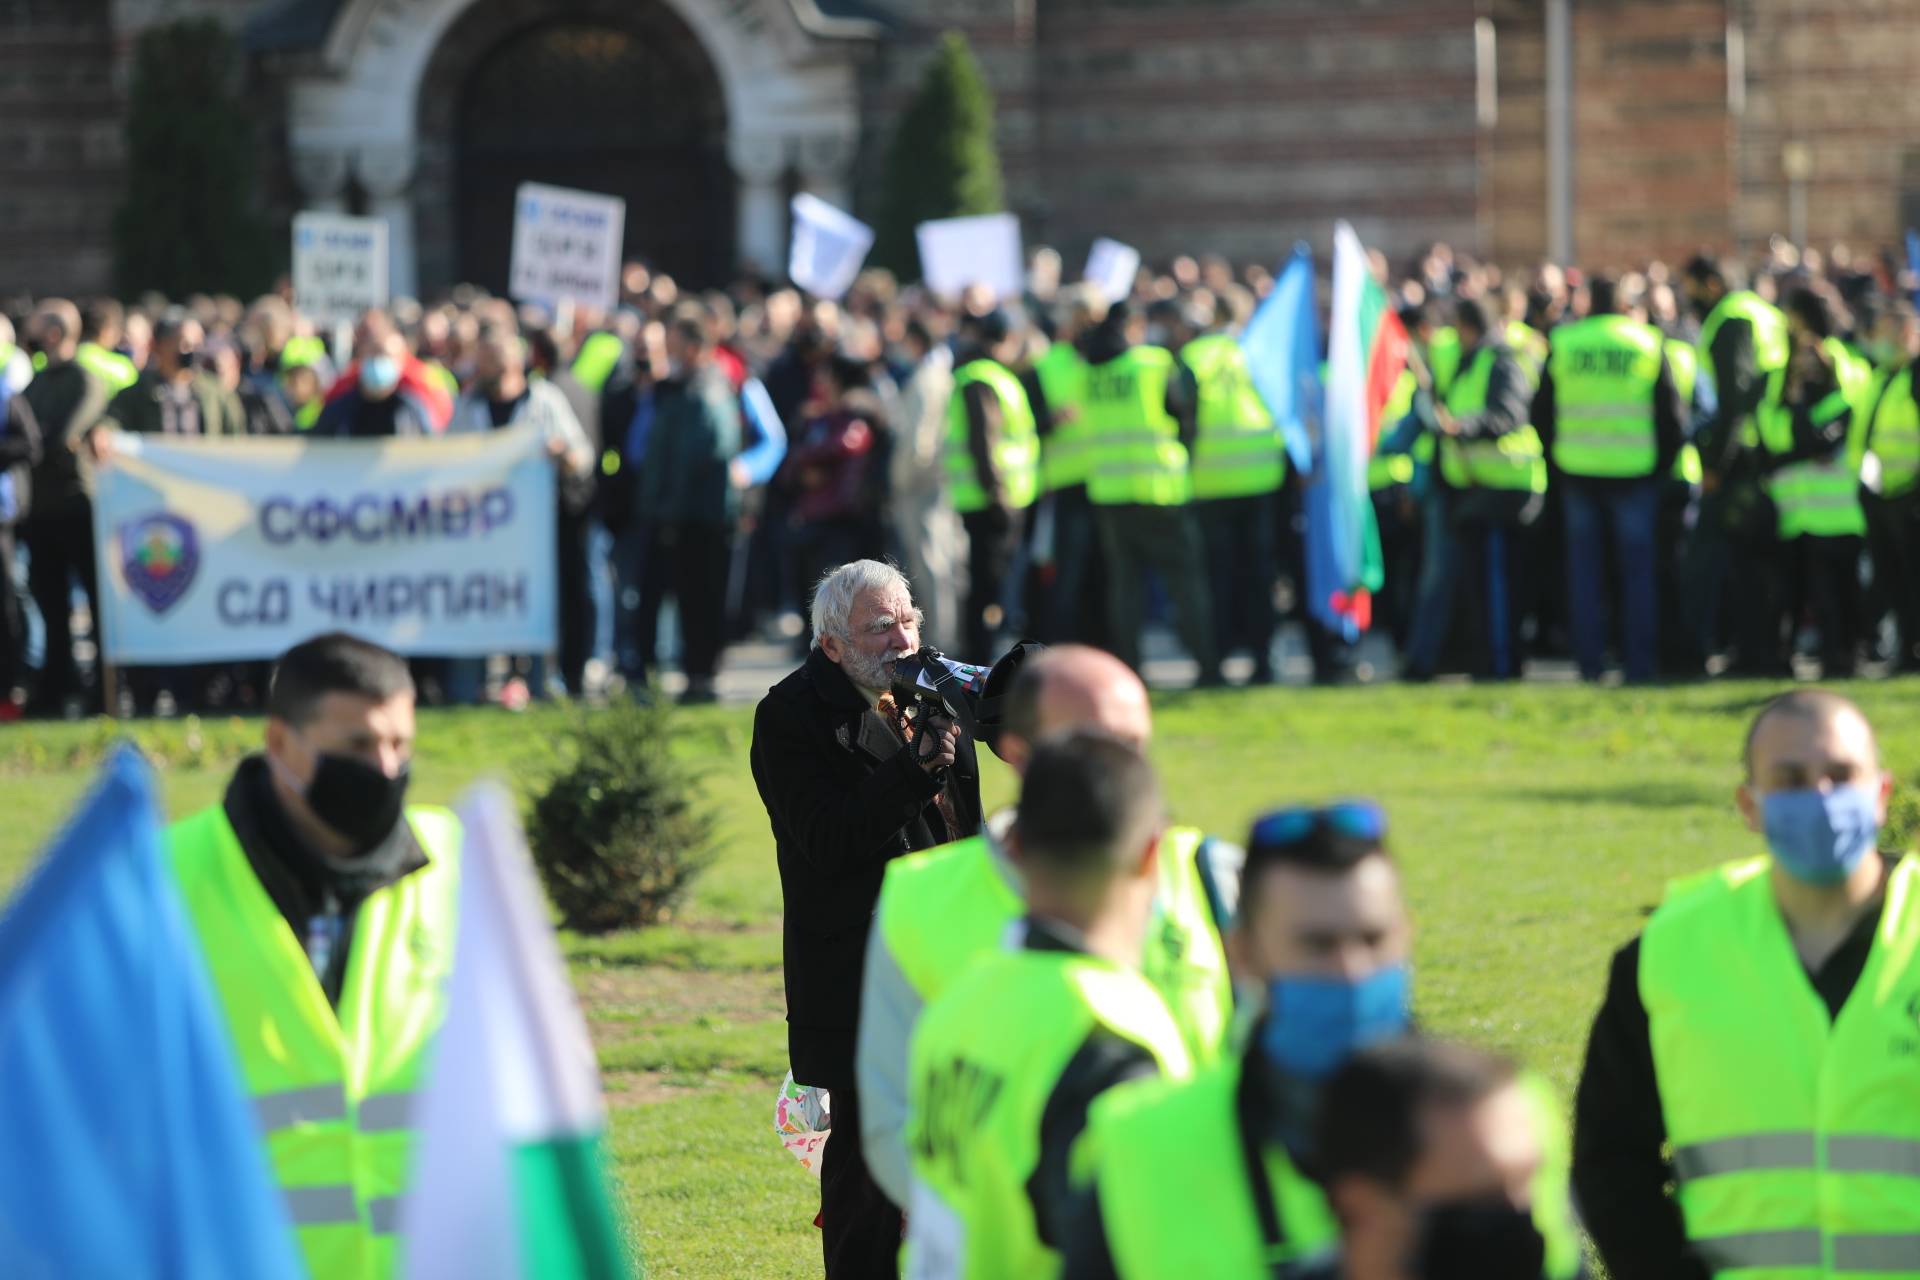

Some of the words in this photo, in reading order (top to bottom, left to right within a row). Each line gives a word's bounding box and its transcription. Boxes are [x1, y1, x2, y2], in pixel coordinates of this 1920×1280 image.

[258, 487, 516, 546] СФСМВР
[215, 577, 293, 628] СД
[308, 568, 529, 625] ЧИРПАН
